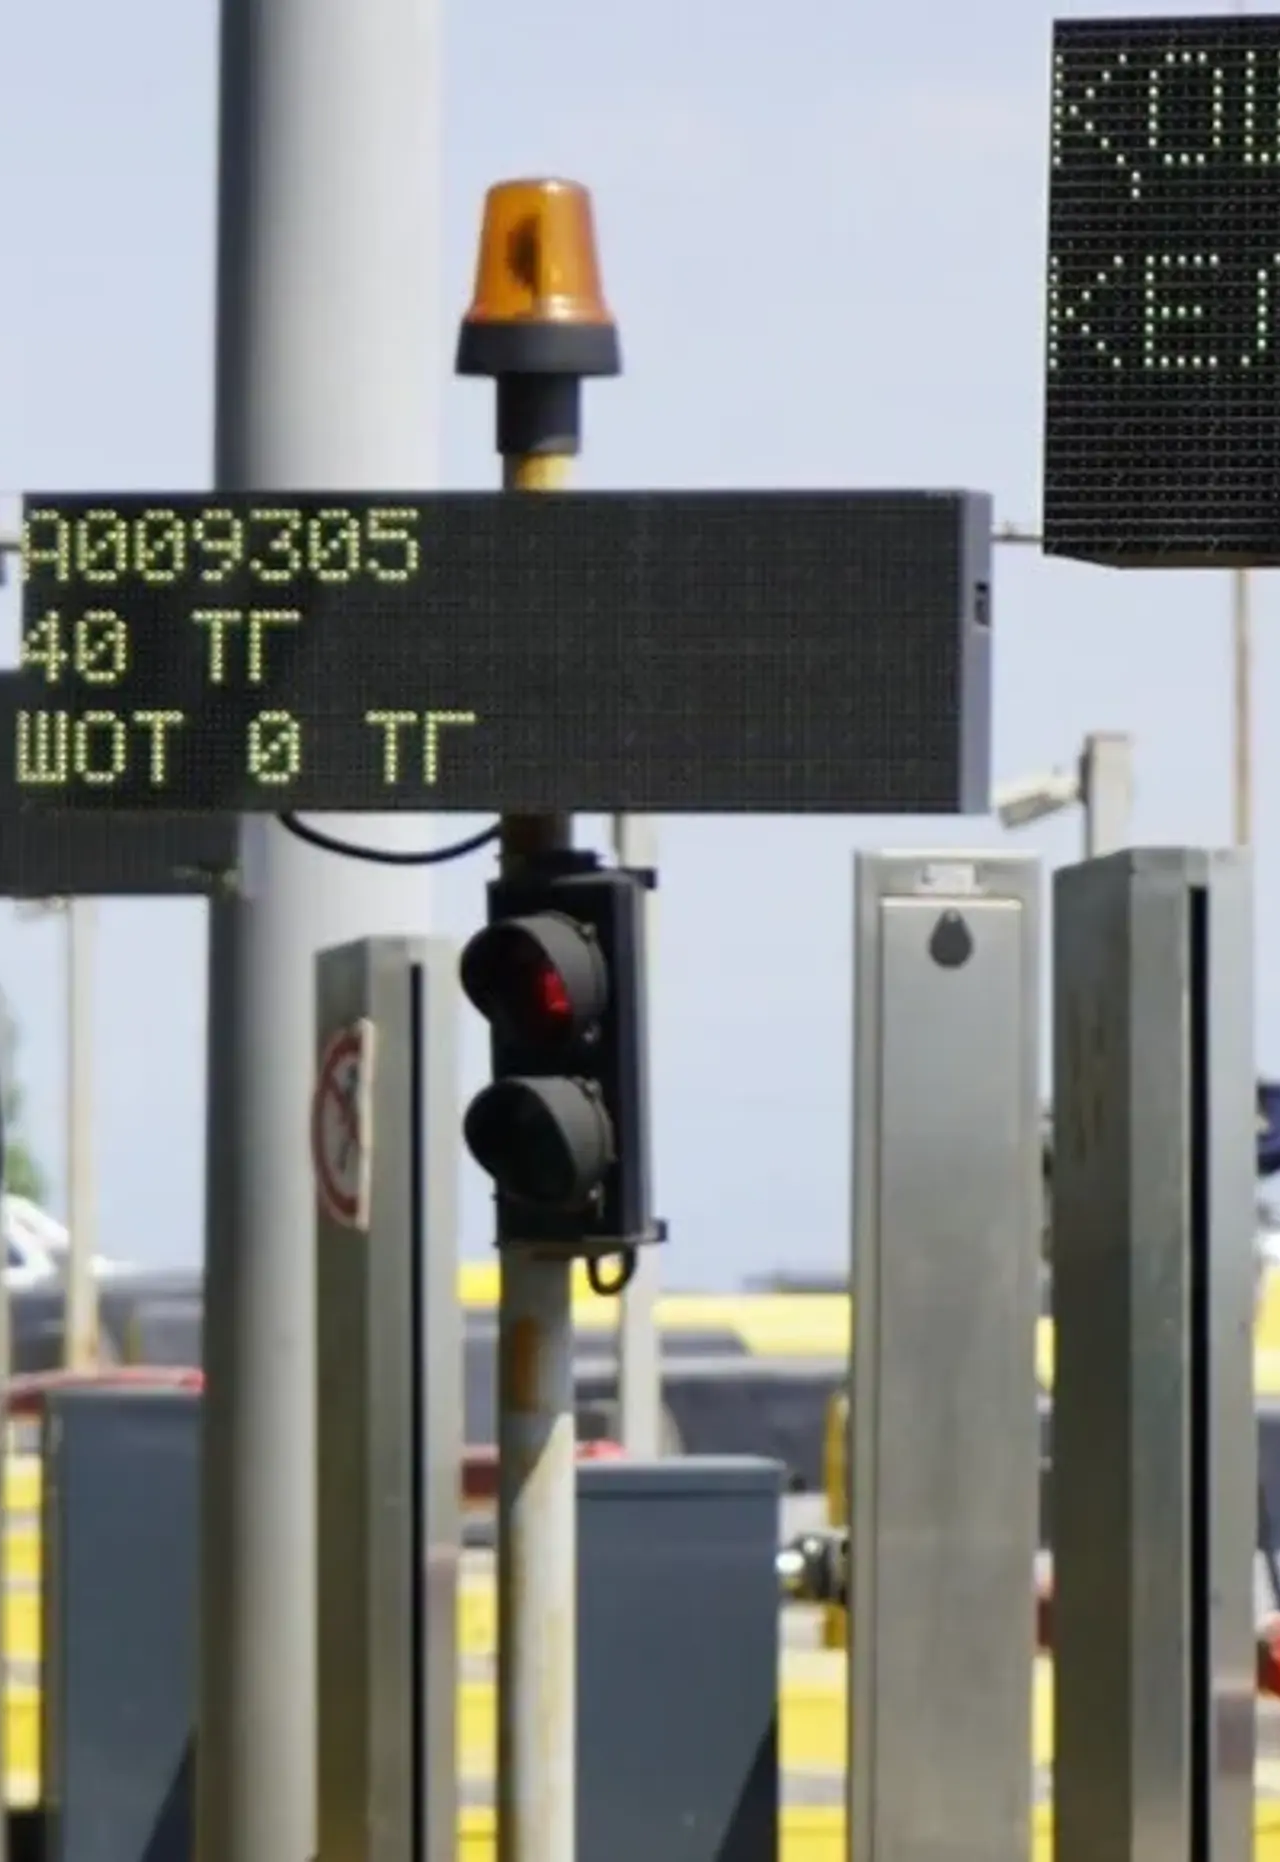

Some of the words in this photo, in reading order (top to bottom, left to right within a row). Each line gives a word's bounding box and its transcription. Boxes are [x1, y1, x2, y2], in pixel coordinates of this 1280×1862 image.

[21, 507, 420, 582] A009305
[19, 609, 128, 683] 40
[190, 609, 303, 683] ТГ
[16, 708, 186, 785] ШОТ
[246, 708, 301, 785] 0
[363, 708, 477, 785] ТГ
